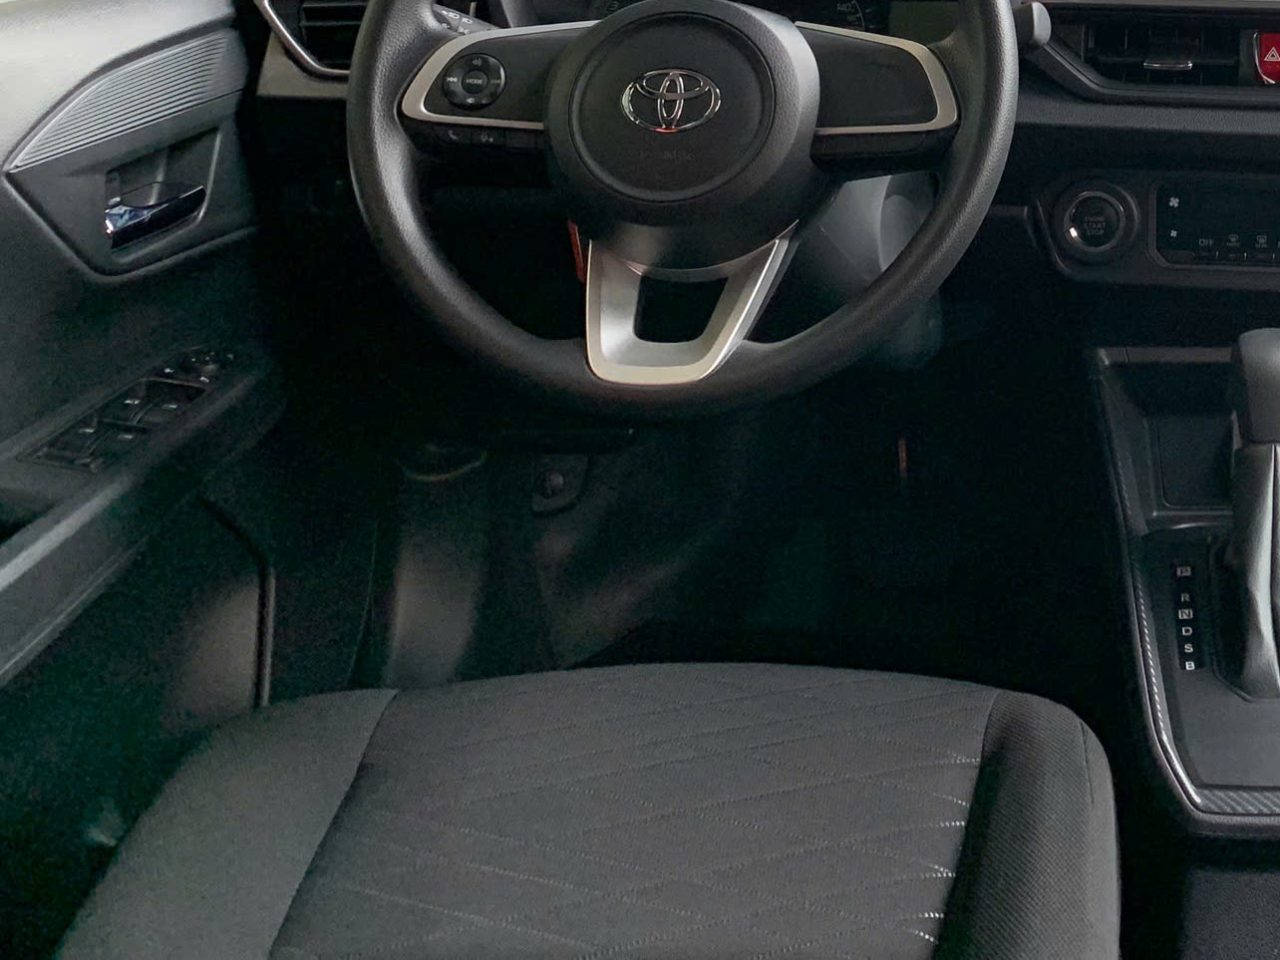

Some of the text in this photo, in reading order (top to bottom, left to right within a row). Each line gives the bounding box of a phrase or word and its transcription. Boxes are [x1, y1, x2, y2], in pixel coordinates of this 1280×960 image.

[1199, 238, 1214, 248] OFF
[1181, 593, 1191, 602] R
[1182, 626, 1193, 636] D
[1184, 643, 1194, 653] S
[1185, 660, 1196, 671] B
